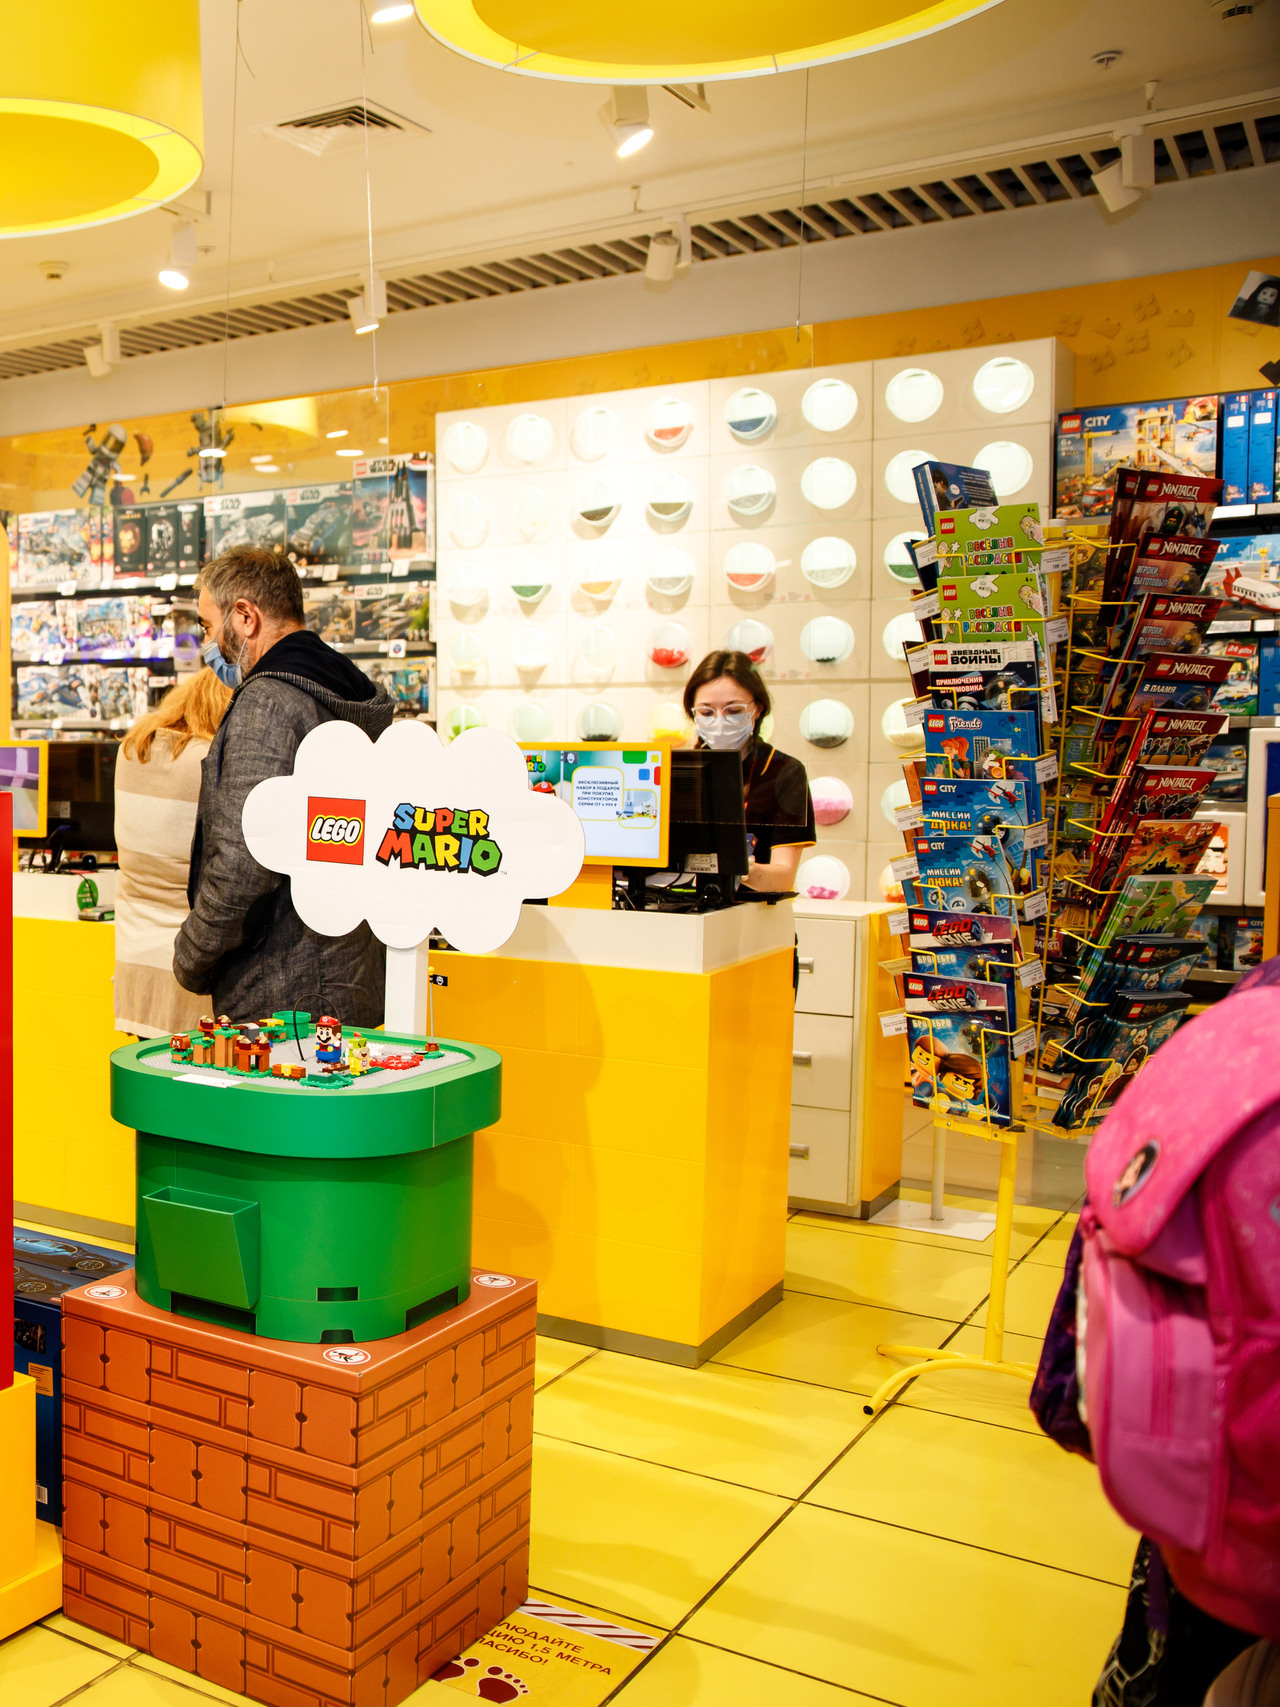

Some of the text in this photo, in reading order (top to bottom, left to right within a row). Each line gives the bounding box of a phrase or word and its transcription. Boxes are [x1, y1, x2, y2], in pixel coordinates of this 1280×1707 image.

[1084, 415, 1111, 428] CITY
[1158, 482, 1201, 501] NINJAGO
[1159, 541, 1204, 560] NINJAGO
[1164, 602, 1207, 618] NINJAGO
[1228, 644, 1238, 652] 24
[1168, 662, 1216, 679] NINJAGO
[935, 676, 984, 686] ПРИКЛЮЧЕНИЯ
[1143, 684, 1178, 694] В ПЛАМЯ
[928, 719, 944, 727] LEGO
[1165, 719, 1207, 733] NINJAGO
[939, 785, 957, 793] CITY
[1155, 777, 1197, 791] NINJAGO
[931, 811, 971, 820] МИССИИ
[311, 803, 490, 844] LEGO SUPER
[376, 828, 503, 877] MARIO
[930, 842, 945, 850] CITY
[926, 868, 961, 877] МИССИИ
[932, 919, 972, 937] LEGO
[933, 932, 977, 946] MOVIE
[916, 954, 957, 965] БРОЕБРО
[927, 985, 967, 1001] LEGO
[928, 998, 972, 1010] MOVIE
[912, 1019, 952, 1029] БРОЕБРО
[497, 1621, 585, 1654] ЛЮДАЙТЕ
[477, 1636, 549, 1666] ПАСИБО!
[530, 1643, 553, 1654] 1,5
[555, 1651, 612, 1676] МЕТРА
